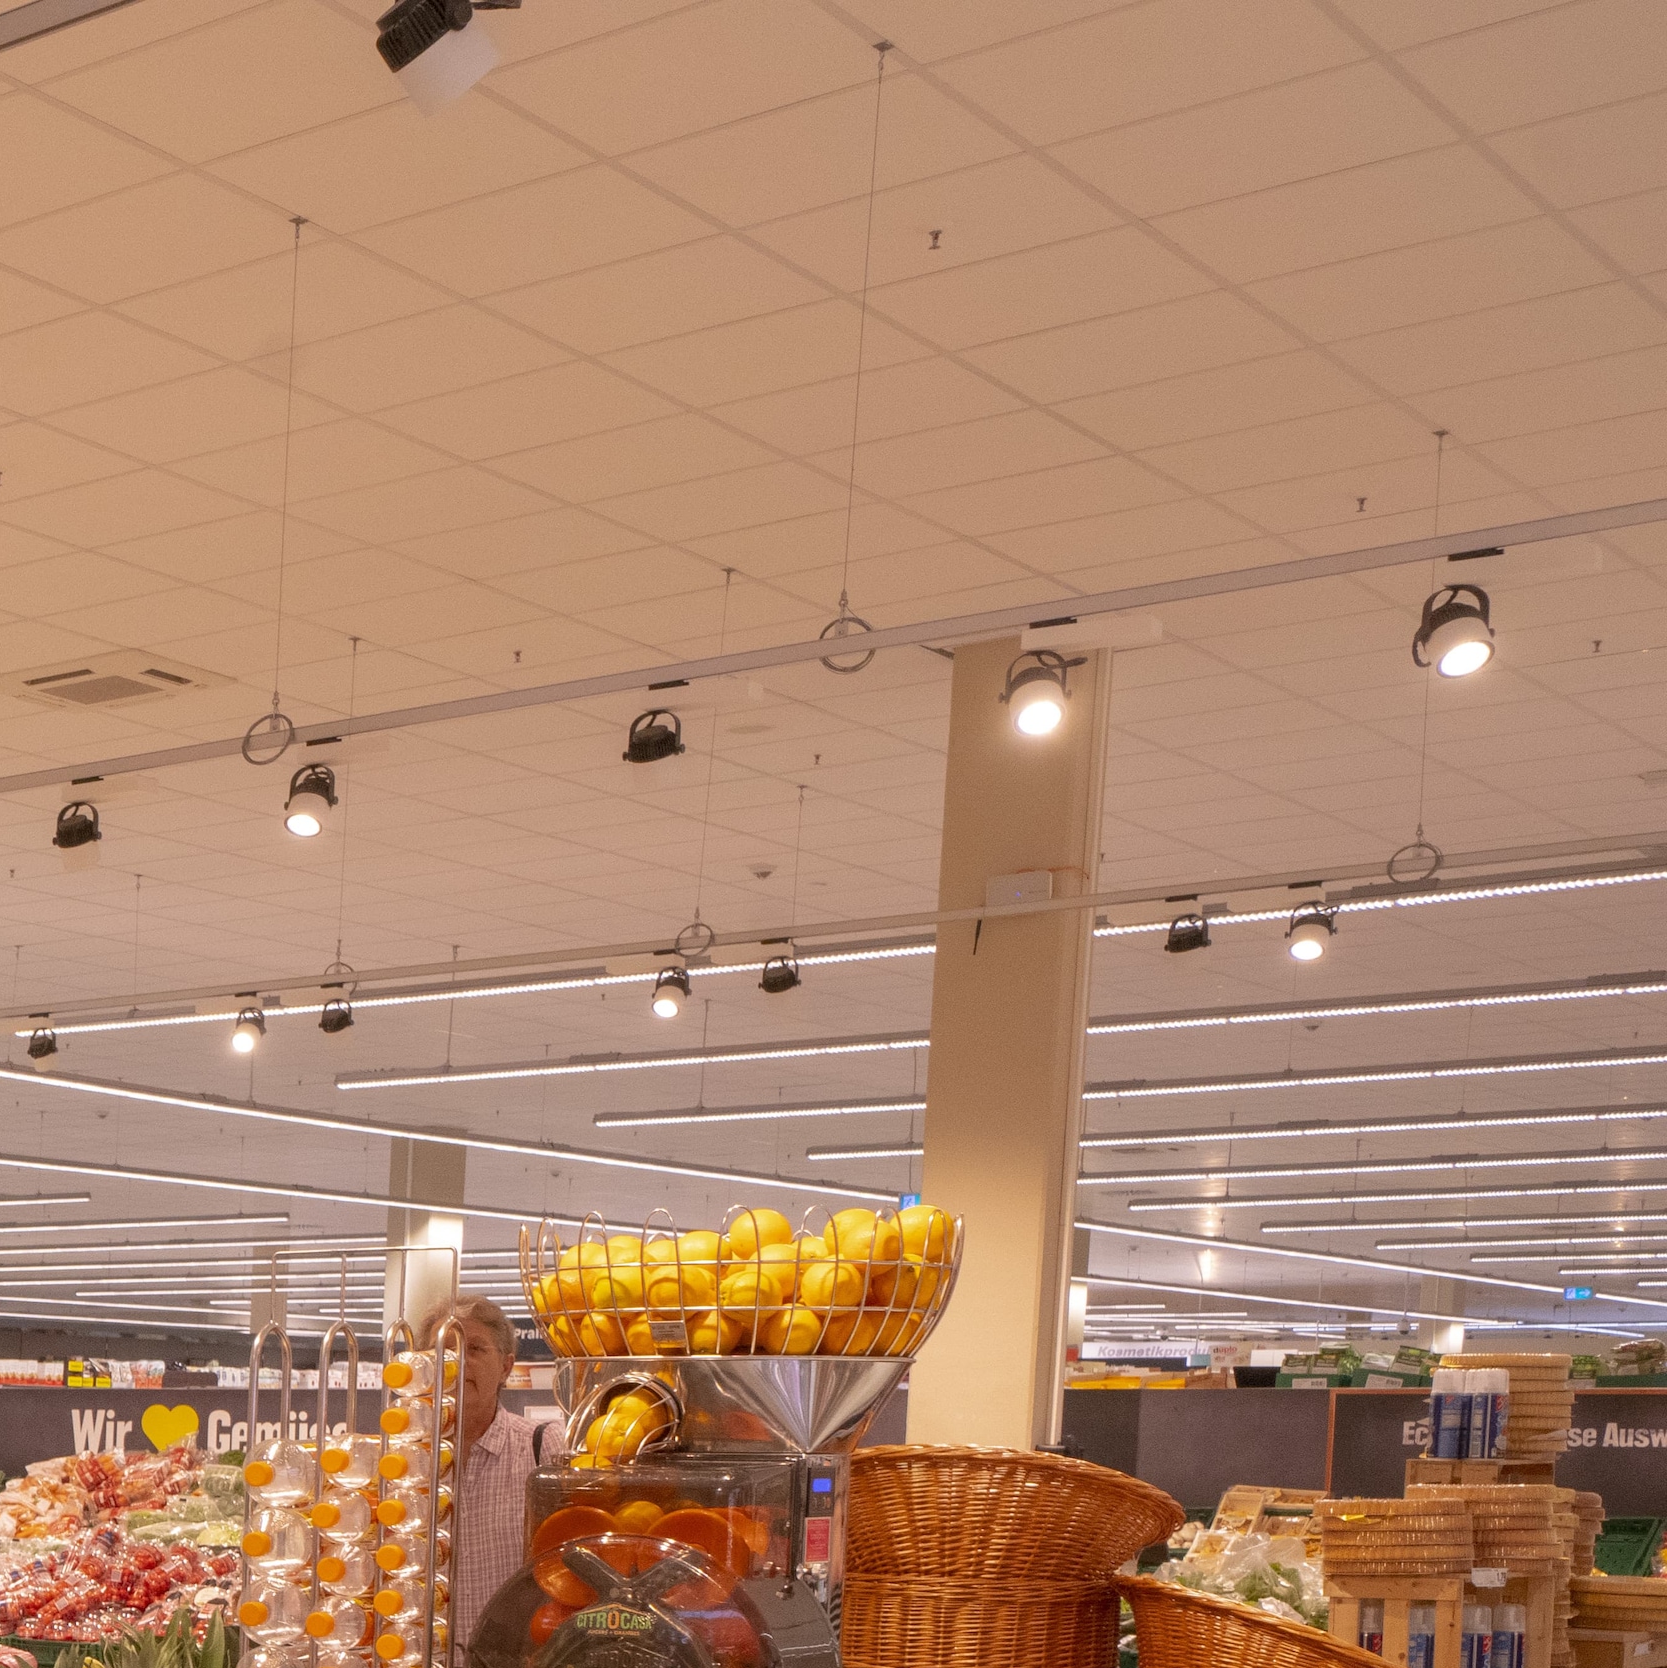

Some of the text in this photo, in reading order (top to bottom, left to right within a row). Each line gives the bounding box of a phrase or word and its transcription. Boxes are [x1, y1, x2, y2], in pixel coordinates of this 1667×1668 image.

[71, 1409, 132, 1455] Wir
[1602, 1422, 1667, 1447] Ausw
[576, 1610, 652, 1630] CITROCASA
